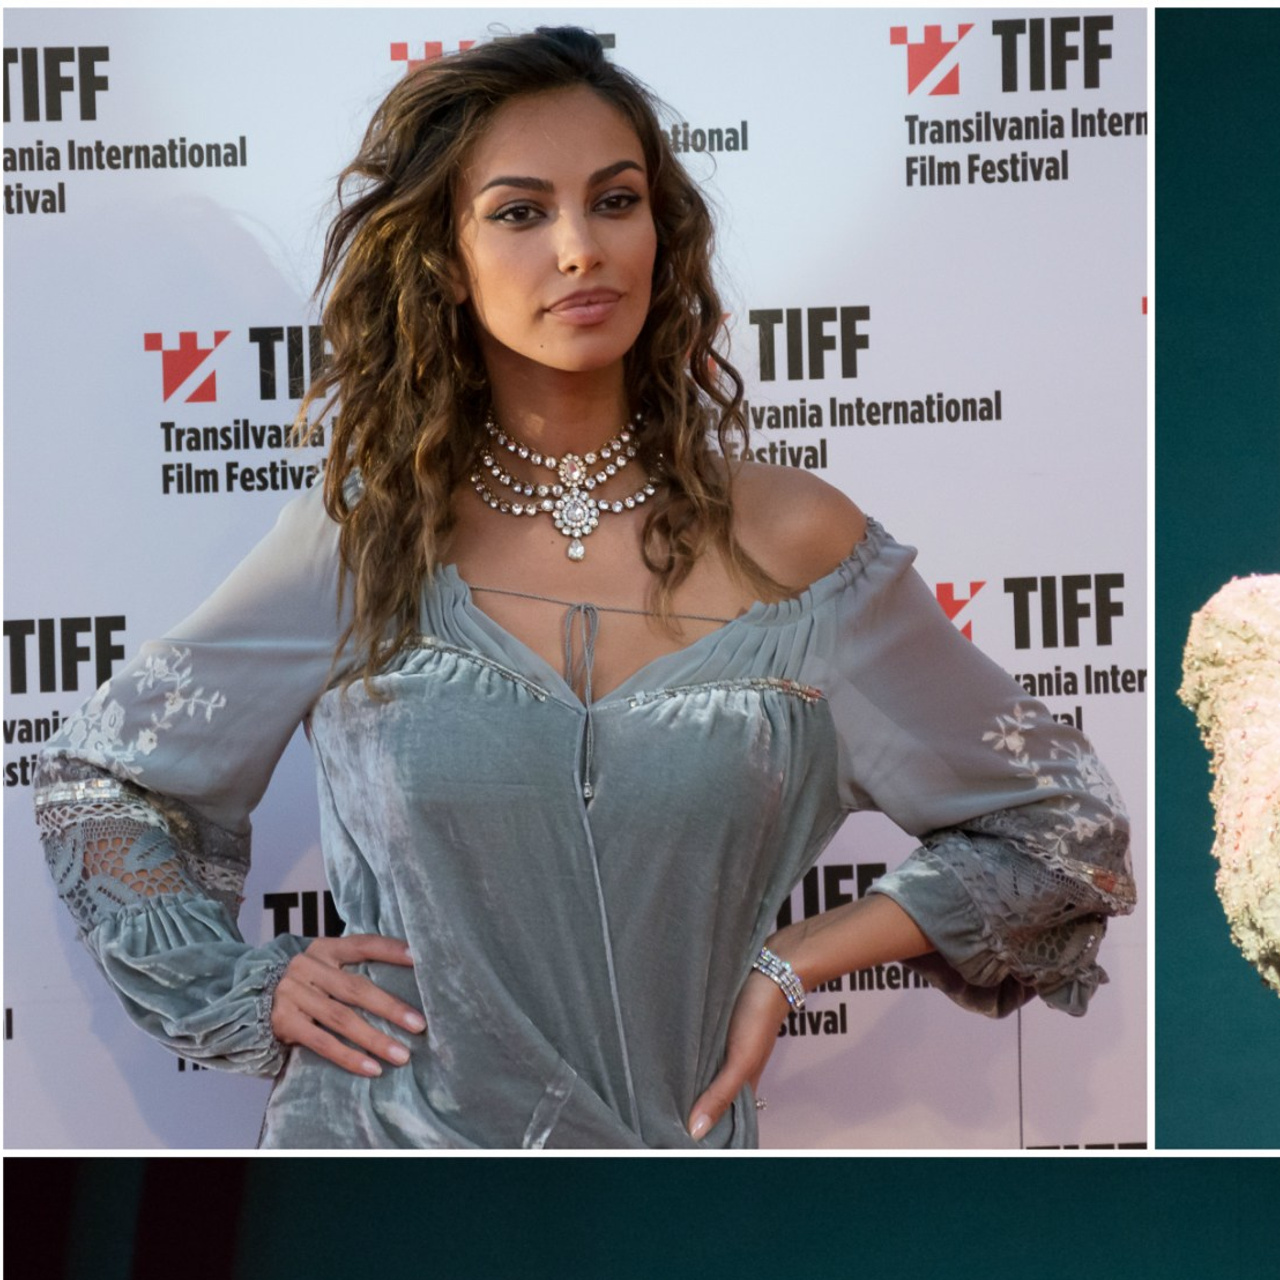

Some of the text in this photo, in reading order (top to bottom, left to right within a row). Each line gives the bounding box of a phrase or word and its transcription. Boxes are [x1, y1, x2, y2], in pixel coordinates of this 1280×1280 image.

[992, 15, 1114, 92] TIFF
[905, 109, 1065, 145] Transilvania
[68, 136, 247, 170] International
[906, 150, 1069, 186] Film Festival
[749, 306, 870, 381] TIFF
[830, 390, 1002, 426] International
[162, 459, 327, 494] Film Festiva
[1004, 573, 1125, 649] TIFF
[3, 615, 126, 695] TIFF
